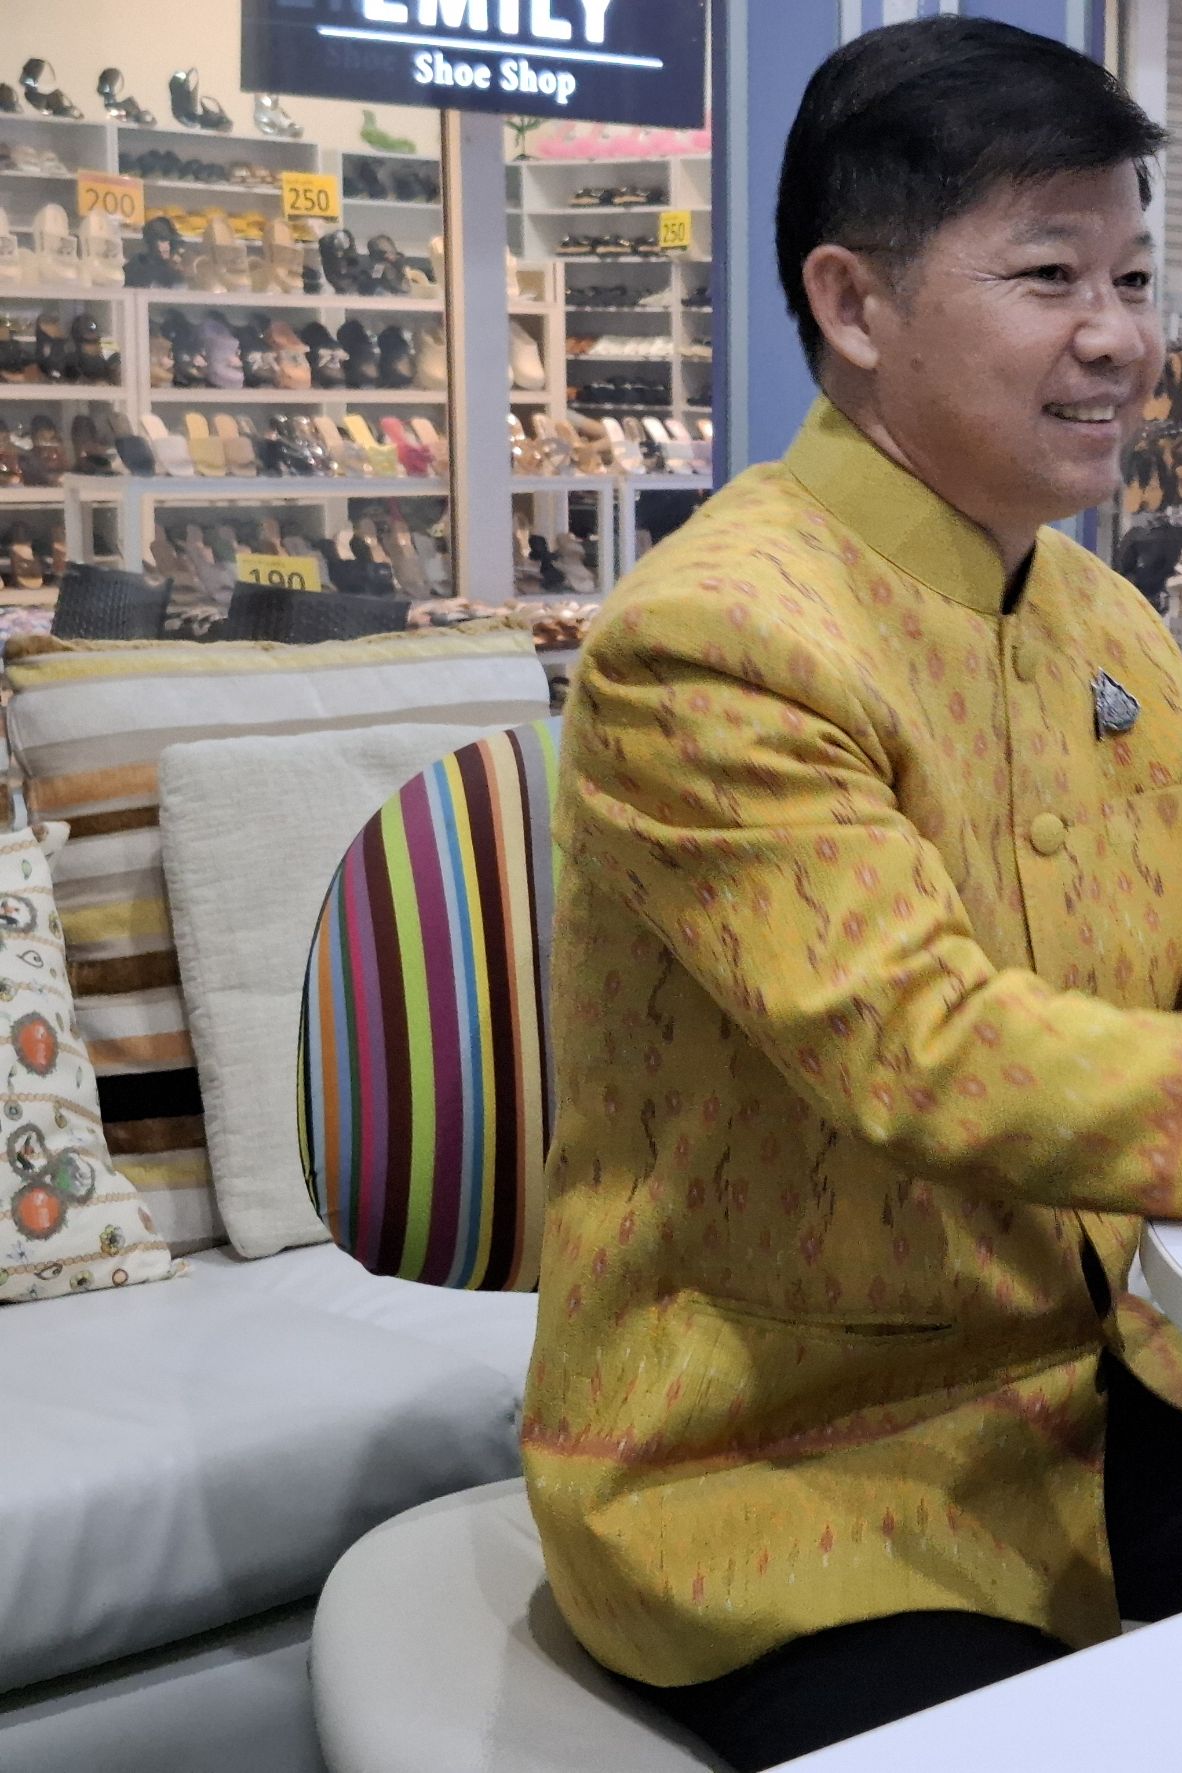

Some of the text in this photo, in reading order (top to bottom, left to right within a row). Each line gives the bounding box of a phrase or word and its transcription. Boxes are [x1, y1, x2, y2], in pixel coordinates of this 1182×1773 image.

[412, 50, 577, 105] Shoe Shop
[85, 188, 136, 218] 200
[288, 188, 330, 212] 250
[663, 222, 686, 243] 250
